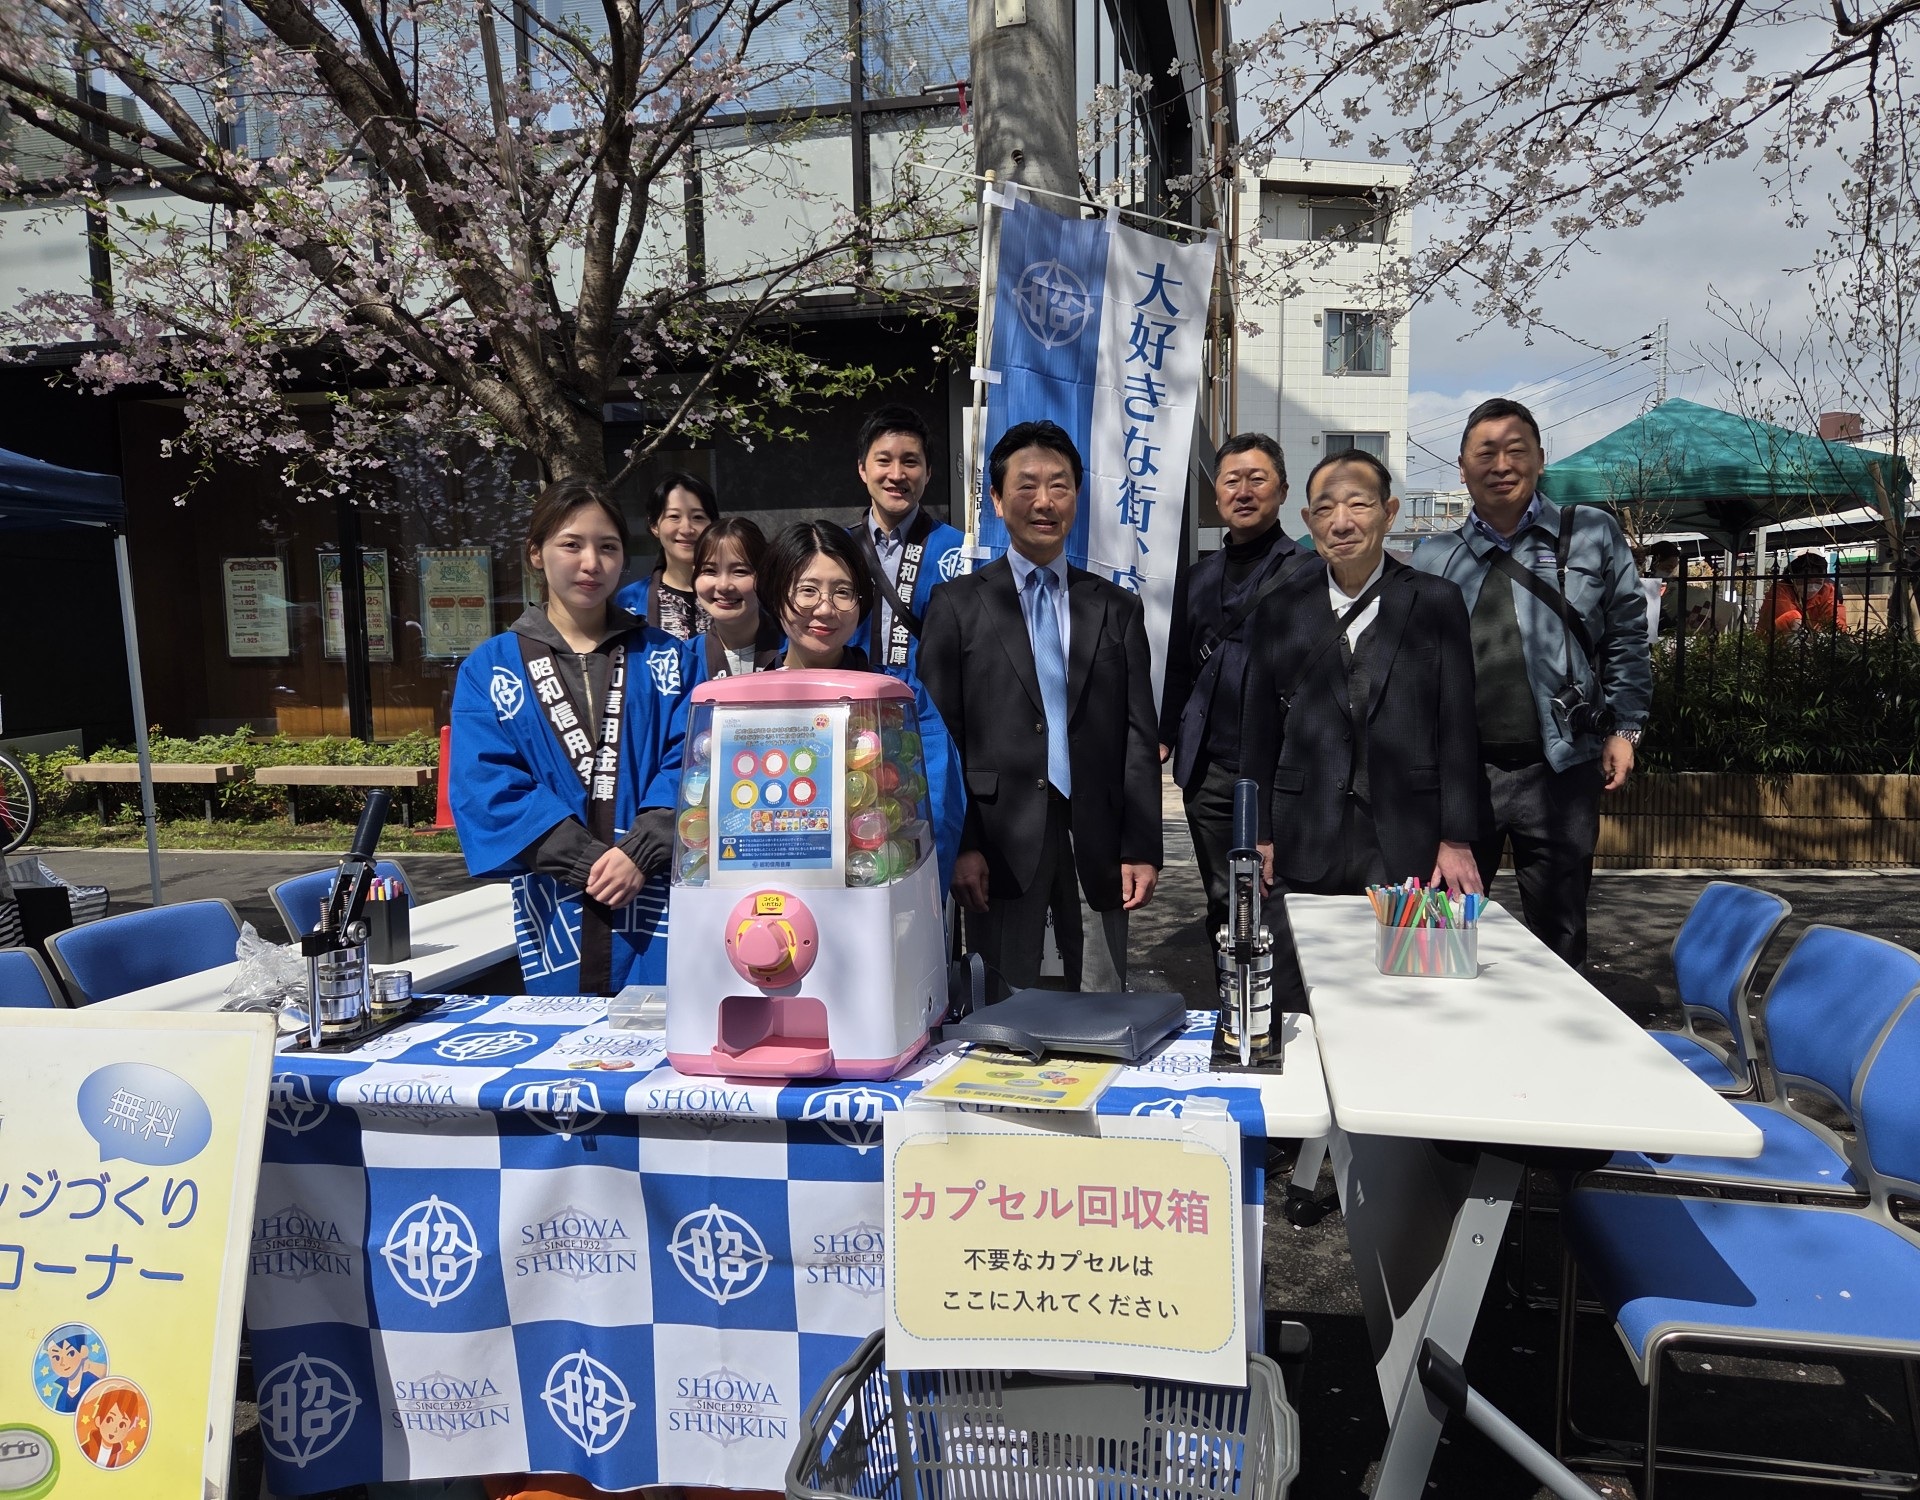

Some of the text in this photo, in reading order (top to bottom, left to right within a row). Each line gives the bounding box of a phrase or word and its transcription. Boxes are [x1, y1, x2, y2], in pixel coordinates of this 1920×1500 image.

[889, 542, 923, 665] 昭和信金庫
[358, 1083, 458, 1104] SHOWA
[647, 1088, 754, 1112] SHOWA
[102, 1086, 182, 1148] 無料
[901, 1179, 1210, 1235] カプセル回収箱
[252, 1216, 341, 1241] HOWA
[521, 1217, 627, 1244] SHOWA
[265, 1238, 300, 1250] SINCE
[544, 1239, 600, 1251] SINCE 1932
[251, 1251, 351, 1277] HINKIN
[515, 1251, 637, 1277] SHINKIN
[834, 1254, 867, 1263] SINCE
[963, 1247, 1154, 1277] 不要なカプセルは
[942, 1290, 1180, 1319] ここに入れてください
[395, 1377, 498, 1401] SHOWA
[677, 1376, 780, 1404] SHOWA
[415, 1400, 473, 1411] SINCE 1932
[696, 1399, 753, 1413] SINCE 1932
[391, 1407, 510, 1431] SHINKIN
[669, 1411, 787, 1440] SHINKIN
